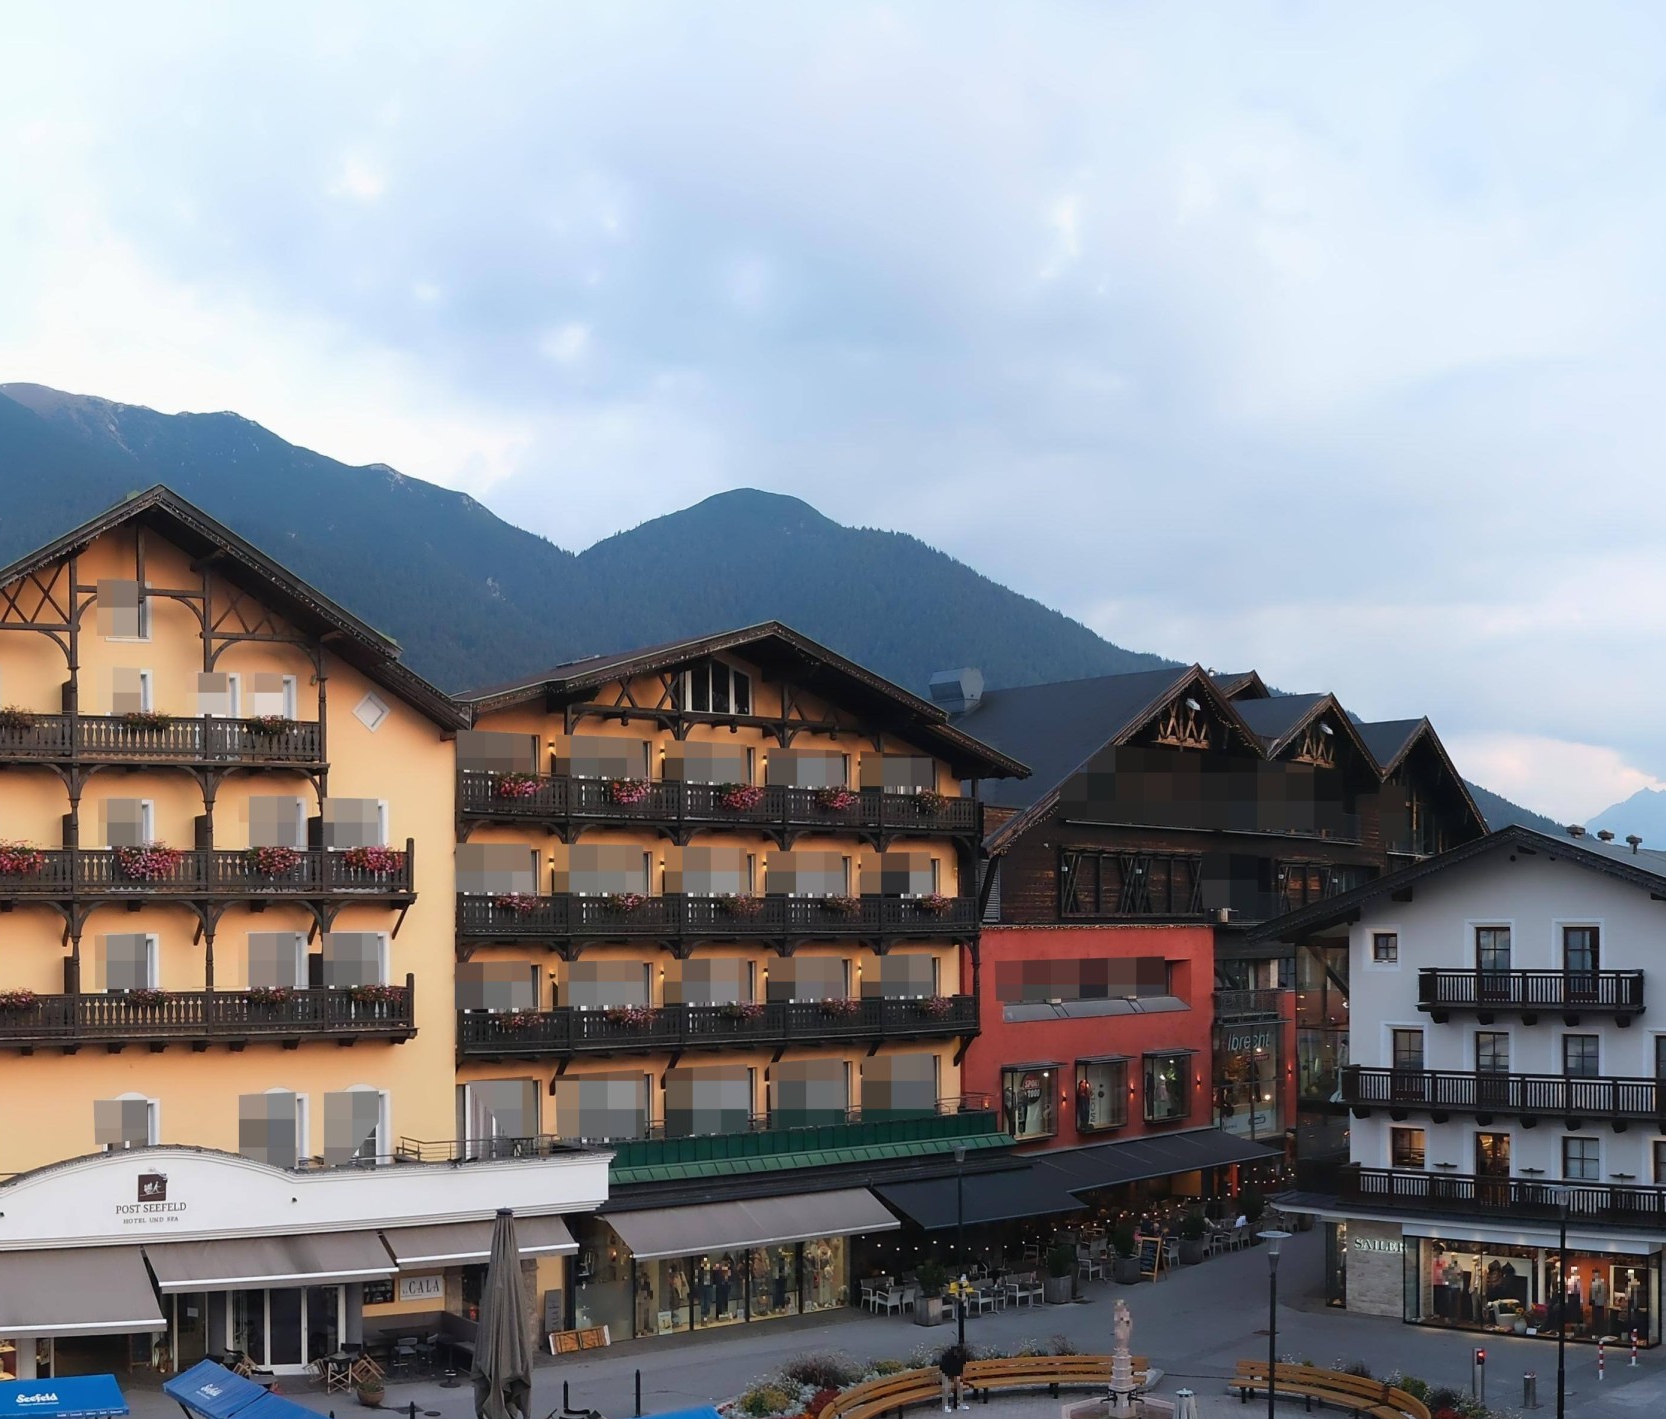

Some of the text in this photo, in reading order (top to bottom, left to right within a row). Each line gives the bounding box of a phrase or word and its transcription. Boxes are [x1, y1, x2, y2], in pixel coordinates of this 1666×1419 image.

[116, 1202, 187, 1215] POST SEEFELD
[123, 1217, 147, 1225] HOTEL
[1354, 1237, 1408, 1254] SAILER
[408, 1278, 440, 1295] CALA
